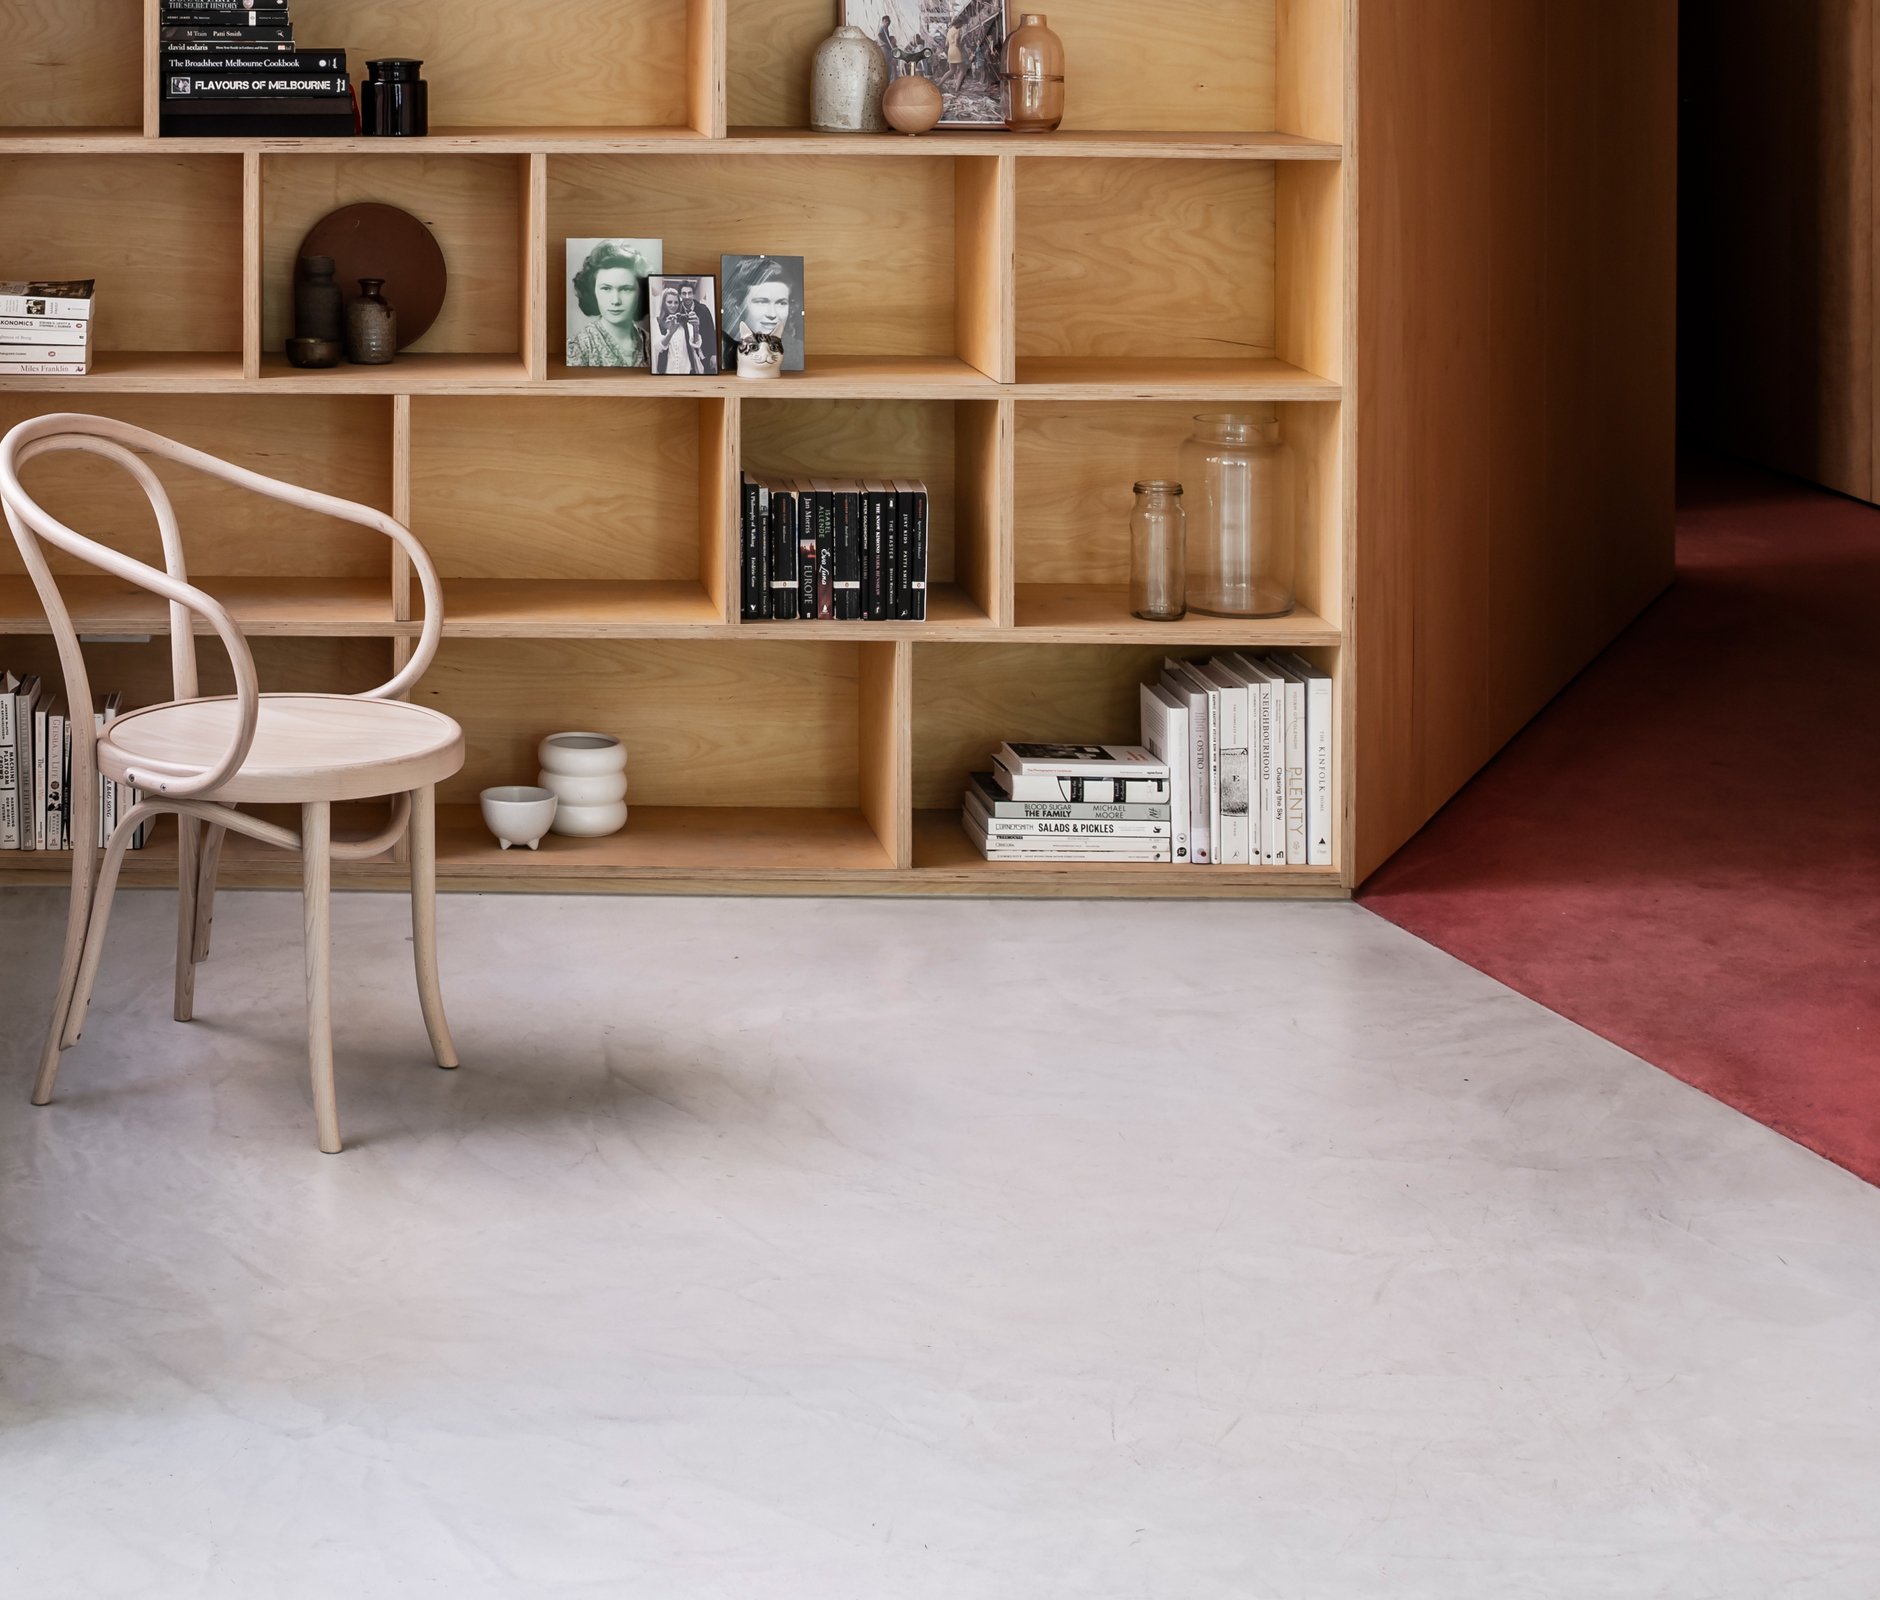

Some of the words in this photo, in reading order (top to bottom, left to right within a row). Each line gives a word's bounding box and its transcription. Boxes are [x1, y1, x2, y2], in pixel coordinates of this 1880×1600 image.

[169, 59, 183, 68] The
[185, 59, 223, 68] Broadsheet
[225, 59, 263, 68] Melbourne
[263, 59, 300, 68] Cookbook
[195, 80, 249, 90] FLAVOURS
[251, 80, 266, 90] OF
[268, 80, 331, 90] MELBOURNE
[804, 498, 812, 509] Jan
[821, 548, 832, 565] Eva
[819, 565, 830, 585] Luna
[804, 565, 813, 604] EUROPE
[1196, 740, 1205, 770] OSTRO
[1318, 746, 1326, 792] KINFOLK
[1289, 767, 1303, 836] PLENTY
[1038, 823, 1071, 833] SALADS
[1073, 824, 1079, 832] &
[1081, 824, 1114, 833] PICKLES
